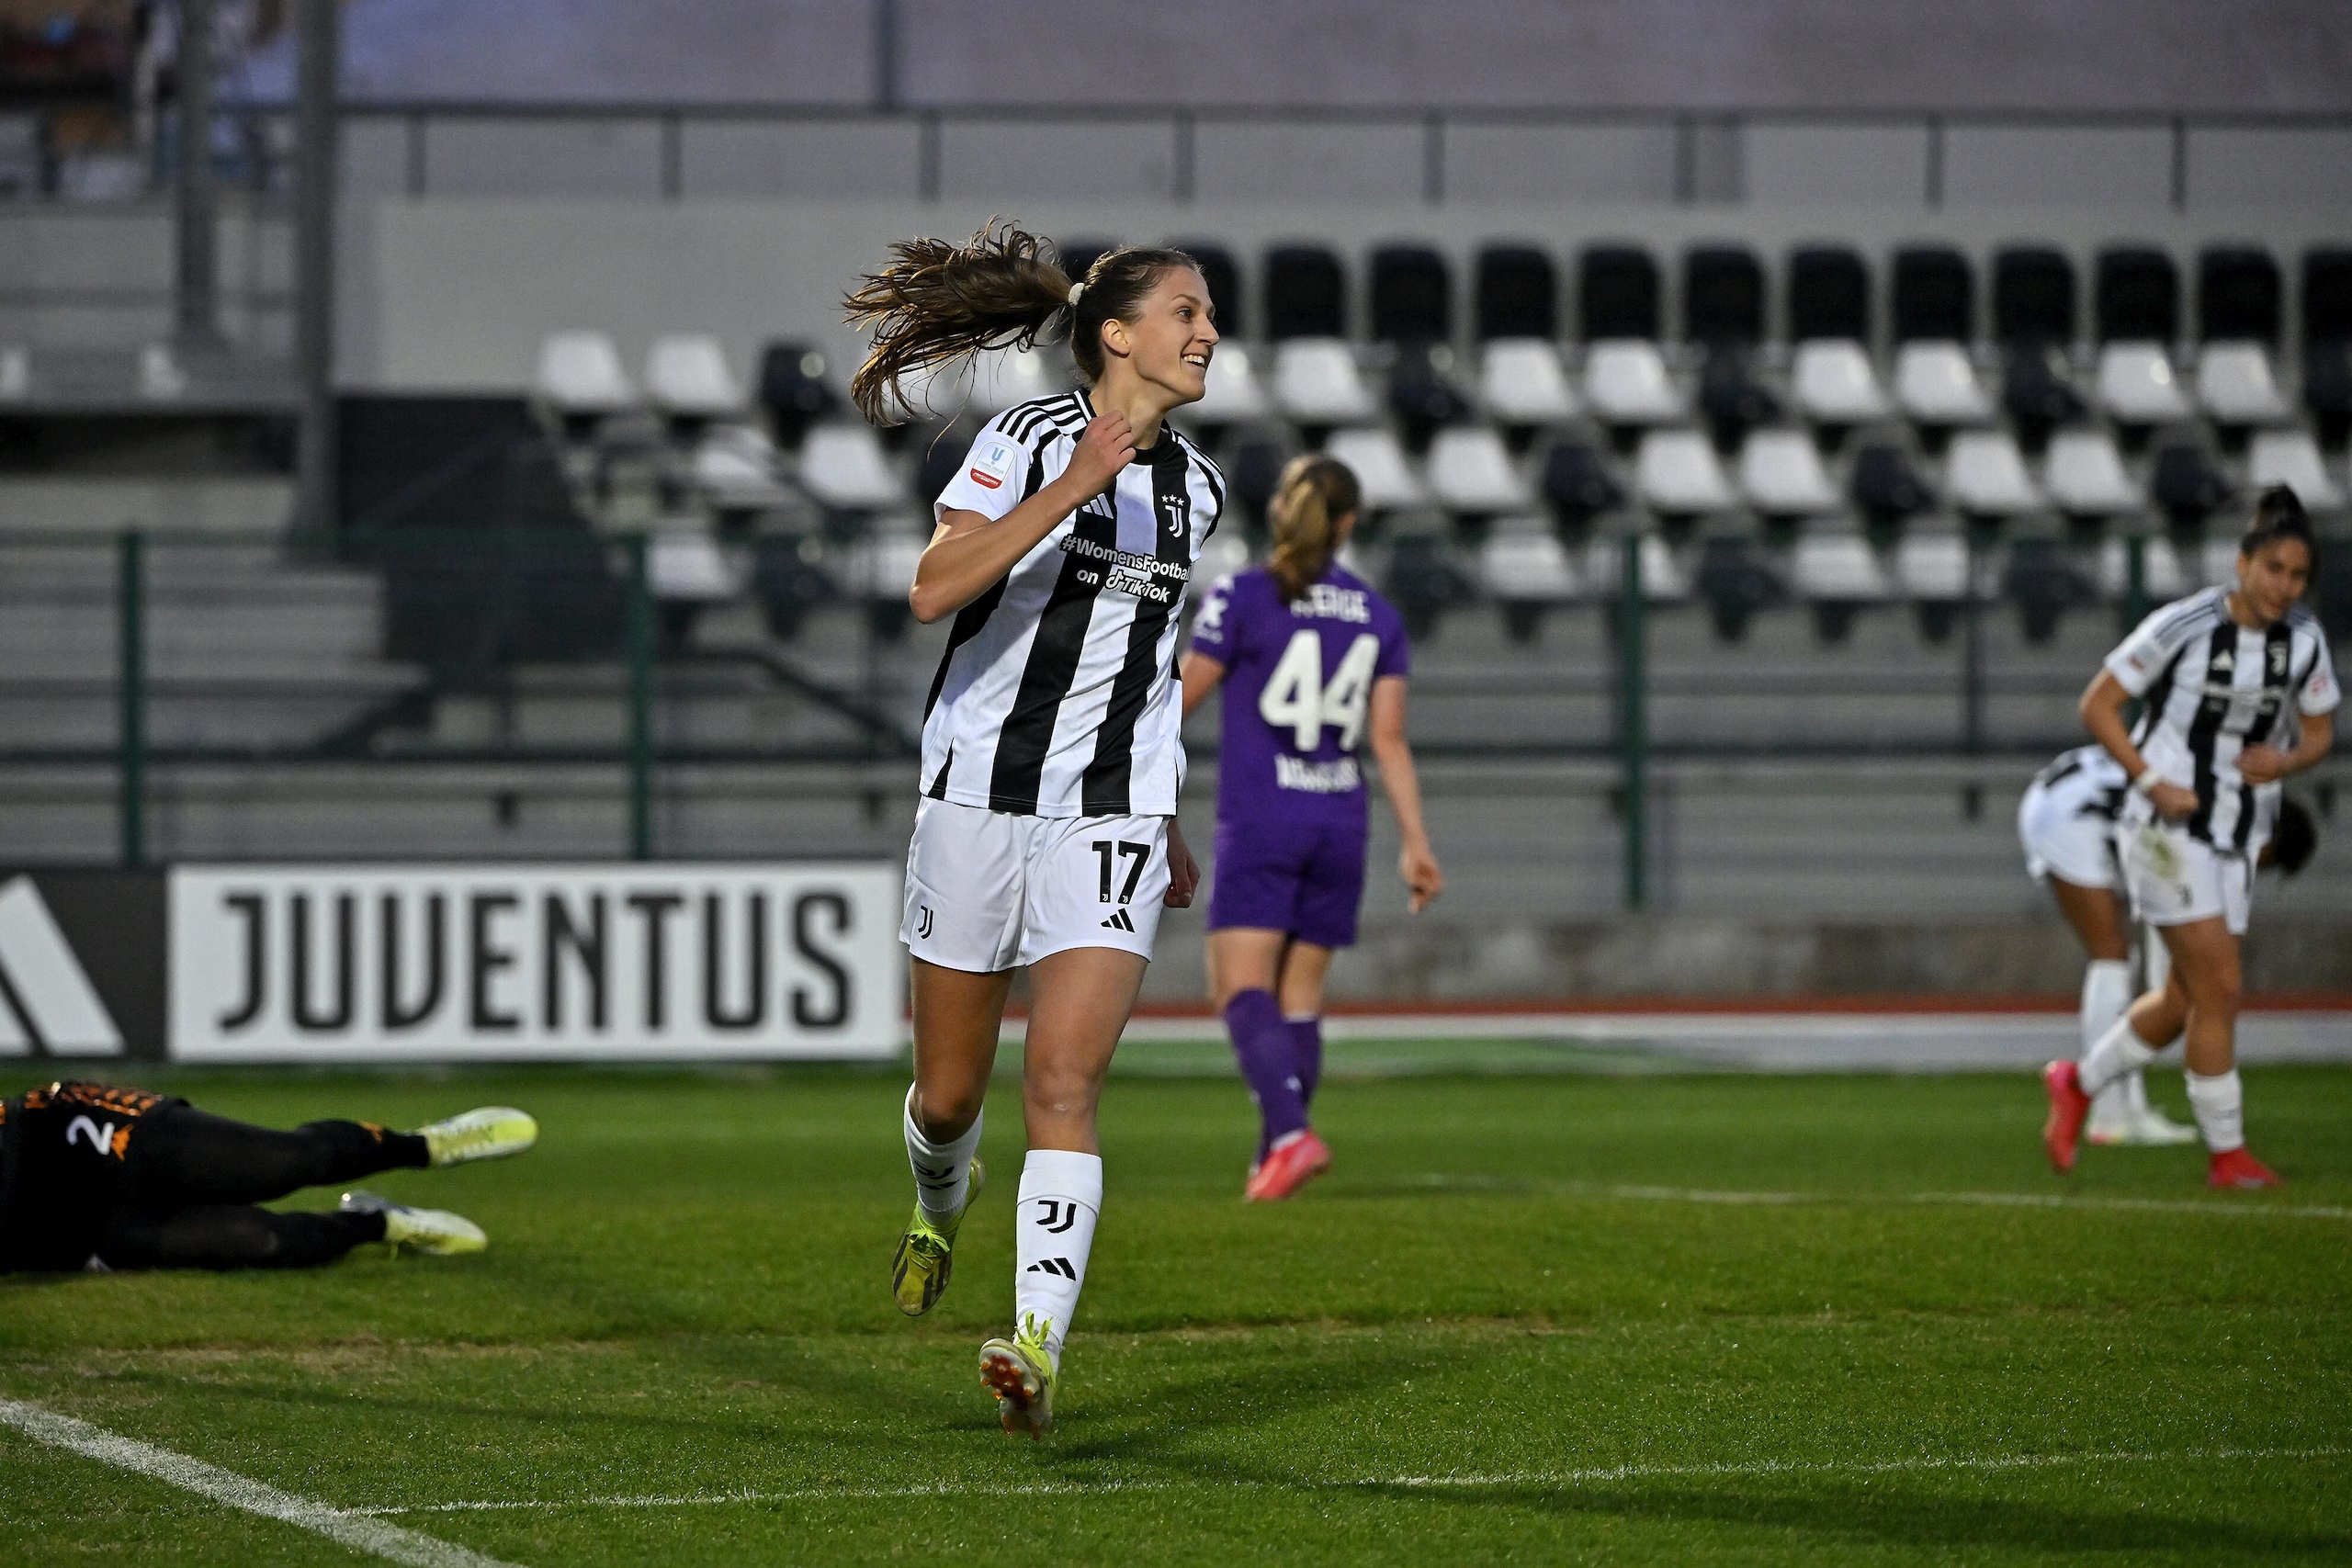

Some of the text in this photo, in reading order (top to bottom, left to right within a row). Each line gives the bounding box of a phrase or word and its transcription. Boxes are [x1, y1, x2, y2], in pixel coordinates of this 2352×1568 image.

[1076, 570, 1170, 604] on TikTok
[1259, 628, 1380, 751] 44
[1091, 840, 1151, 904] 17
[219, 889, 856, 1037] JUVENTUS
[66, 1114, 115, 1156] 2
